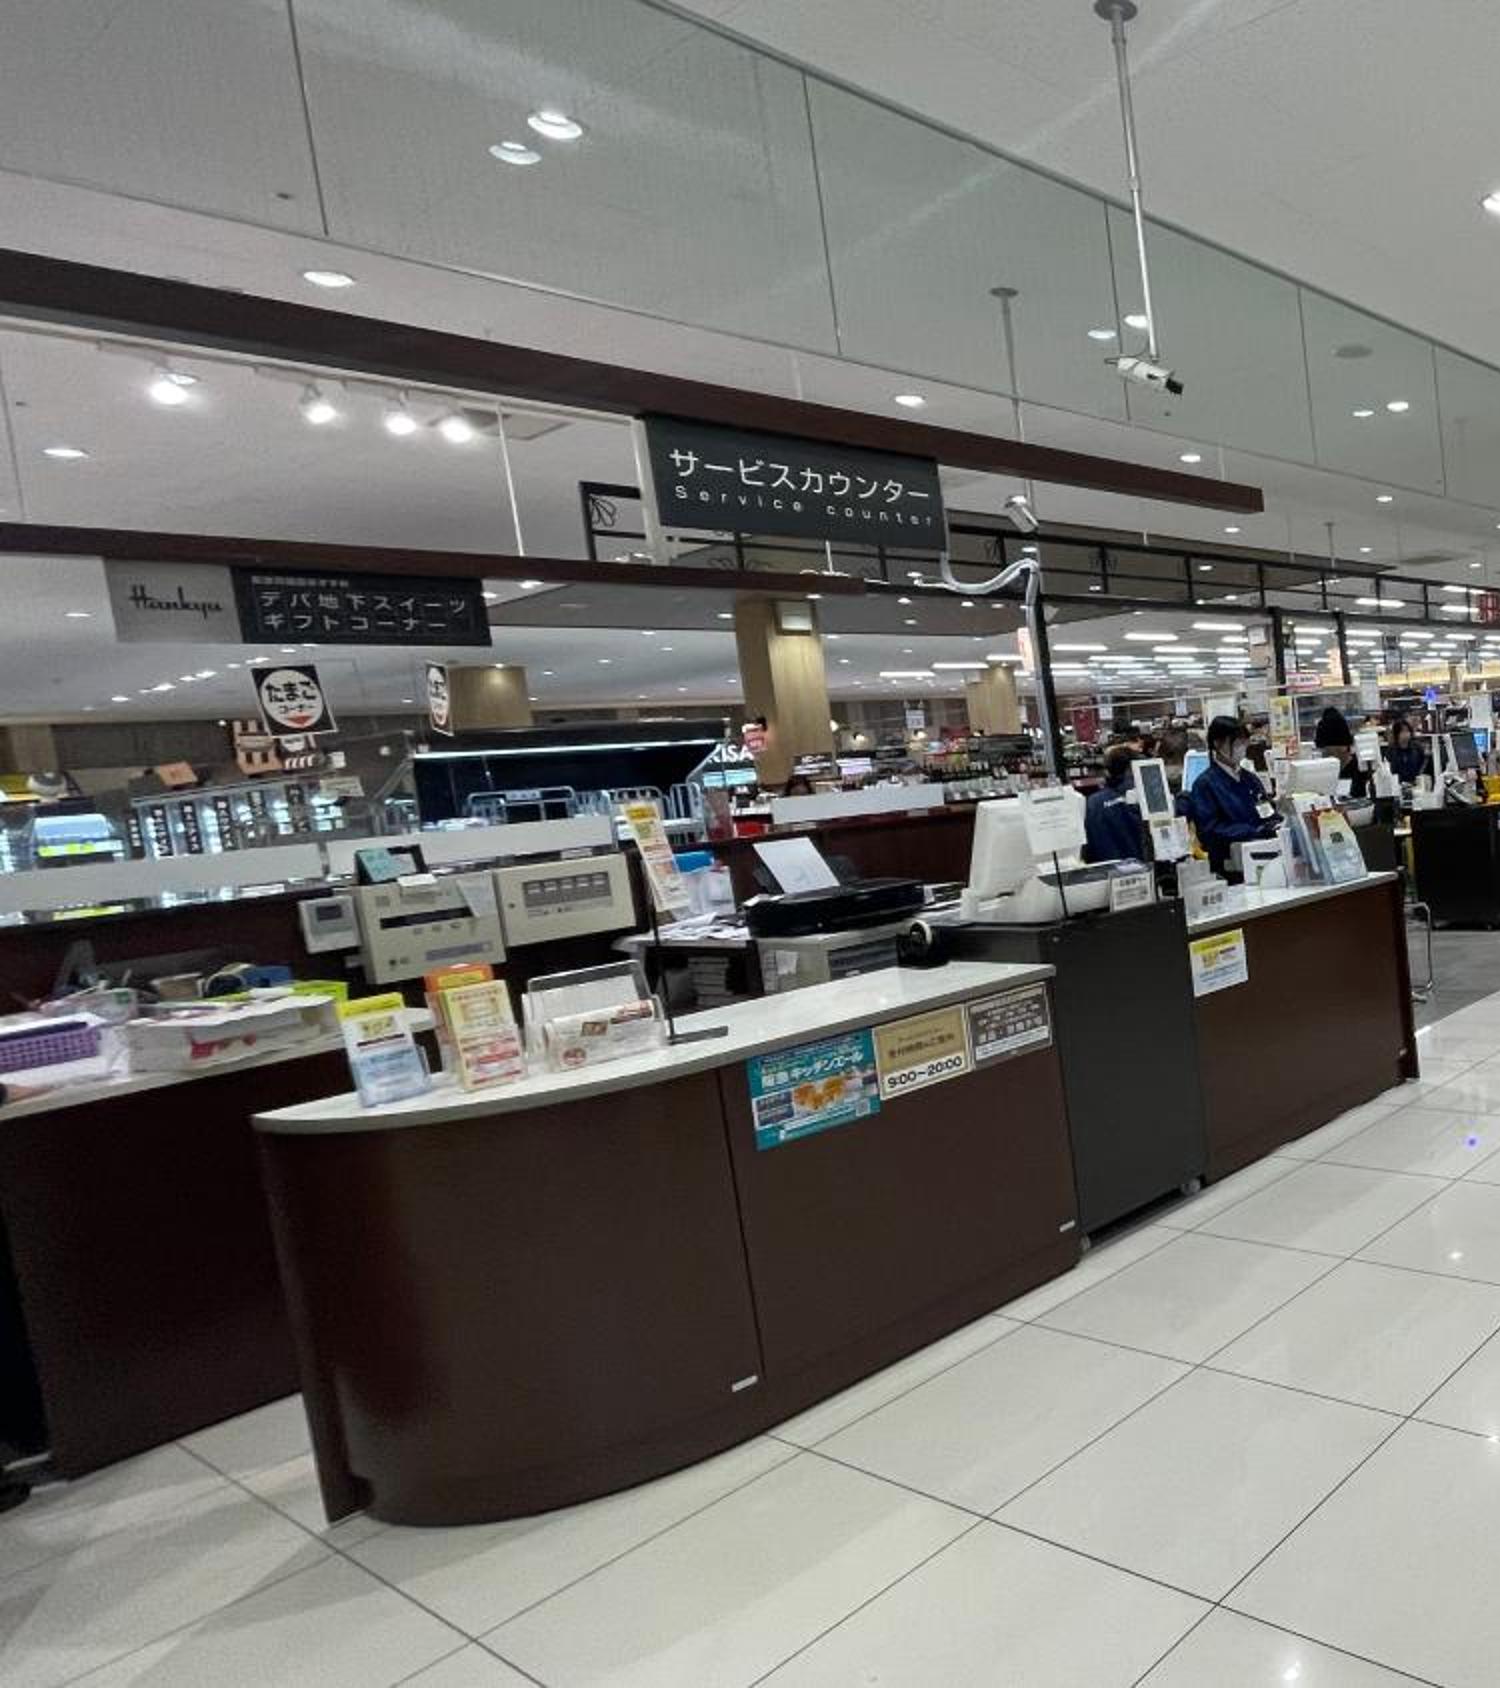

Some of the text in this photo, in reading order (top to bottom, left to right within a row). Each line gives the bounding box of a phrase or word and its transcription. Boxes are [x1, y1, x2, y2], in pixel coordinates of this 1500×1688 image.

[669, 449, 929, 502] サービスカウンター
[675, 485, 932, 527] Service counter
[260, 591, 465, 613] デパ地下スイーツ
[264, 613, 447, 630] ギフトコーナー
